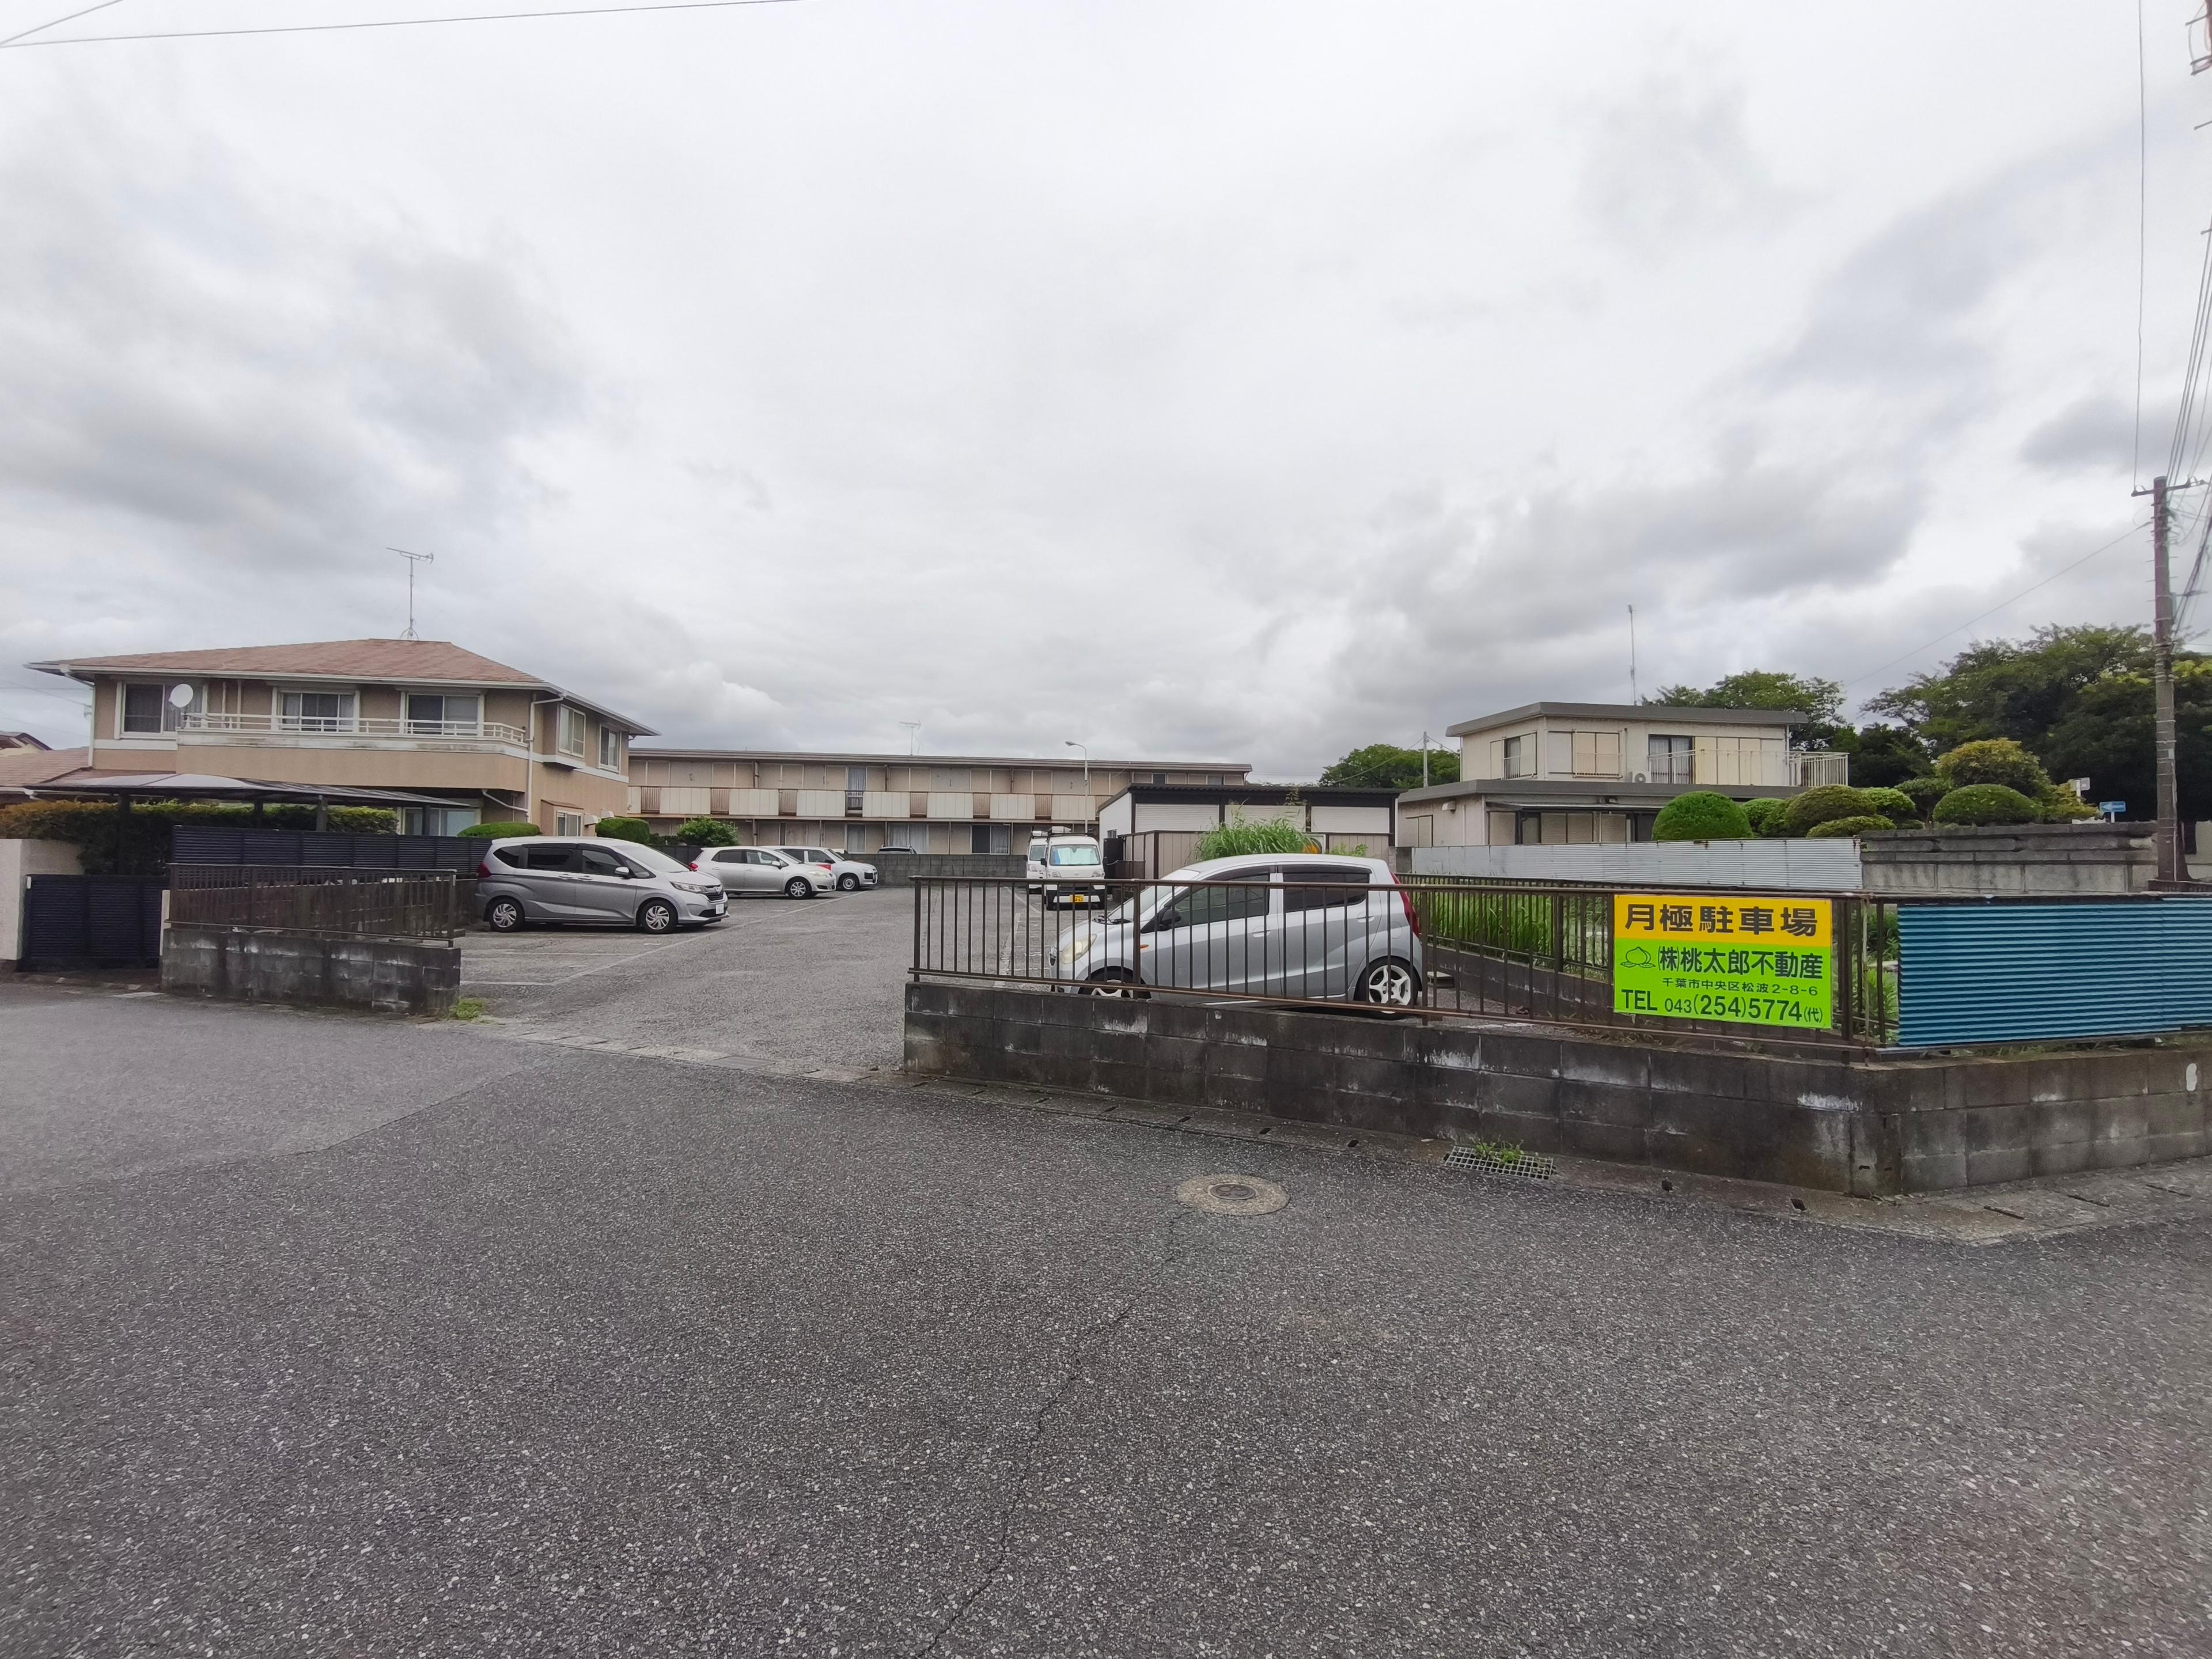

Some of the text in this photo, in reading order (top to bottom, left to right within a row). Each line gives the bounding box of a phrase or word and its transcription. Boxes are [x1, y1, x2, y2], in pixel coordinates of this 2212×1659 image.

[1624, 903, 1818, 937] 月極駐車場
[1662, 978, 1818, 997] 千葉市中央区松波2-8-6
[1621, 988, 1658, 1012] TEL
